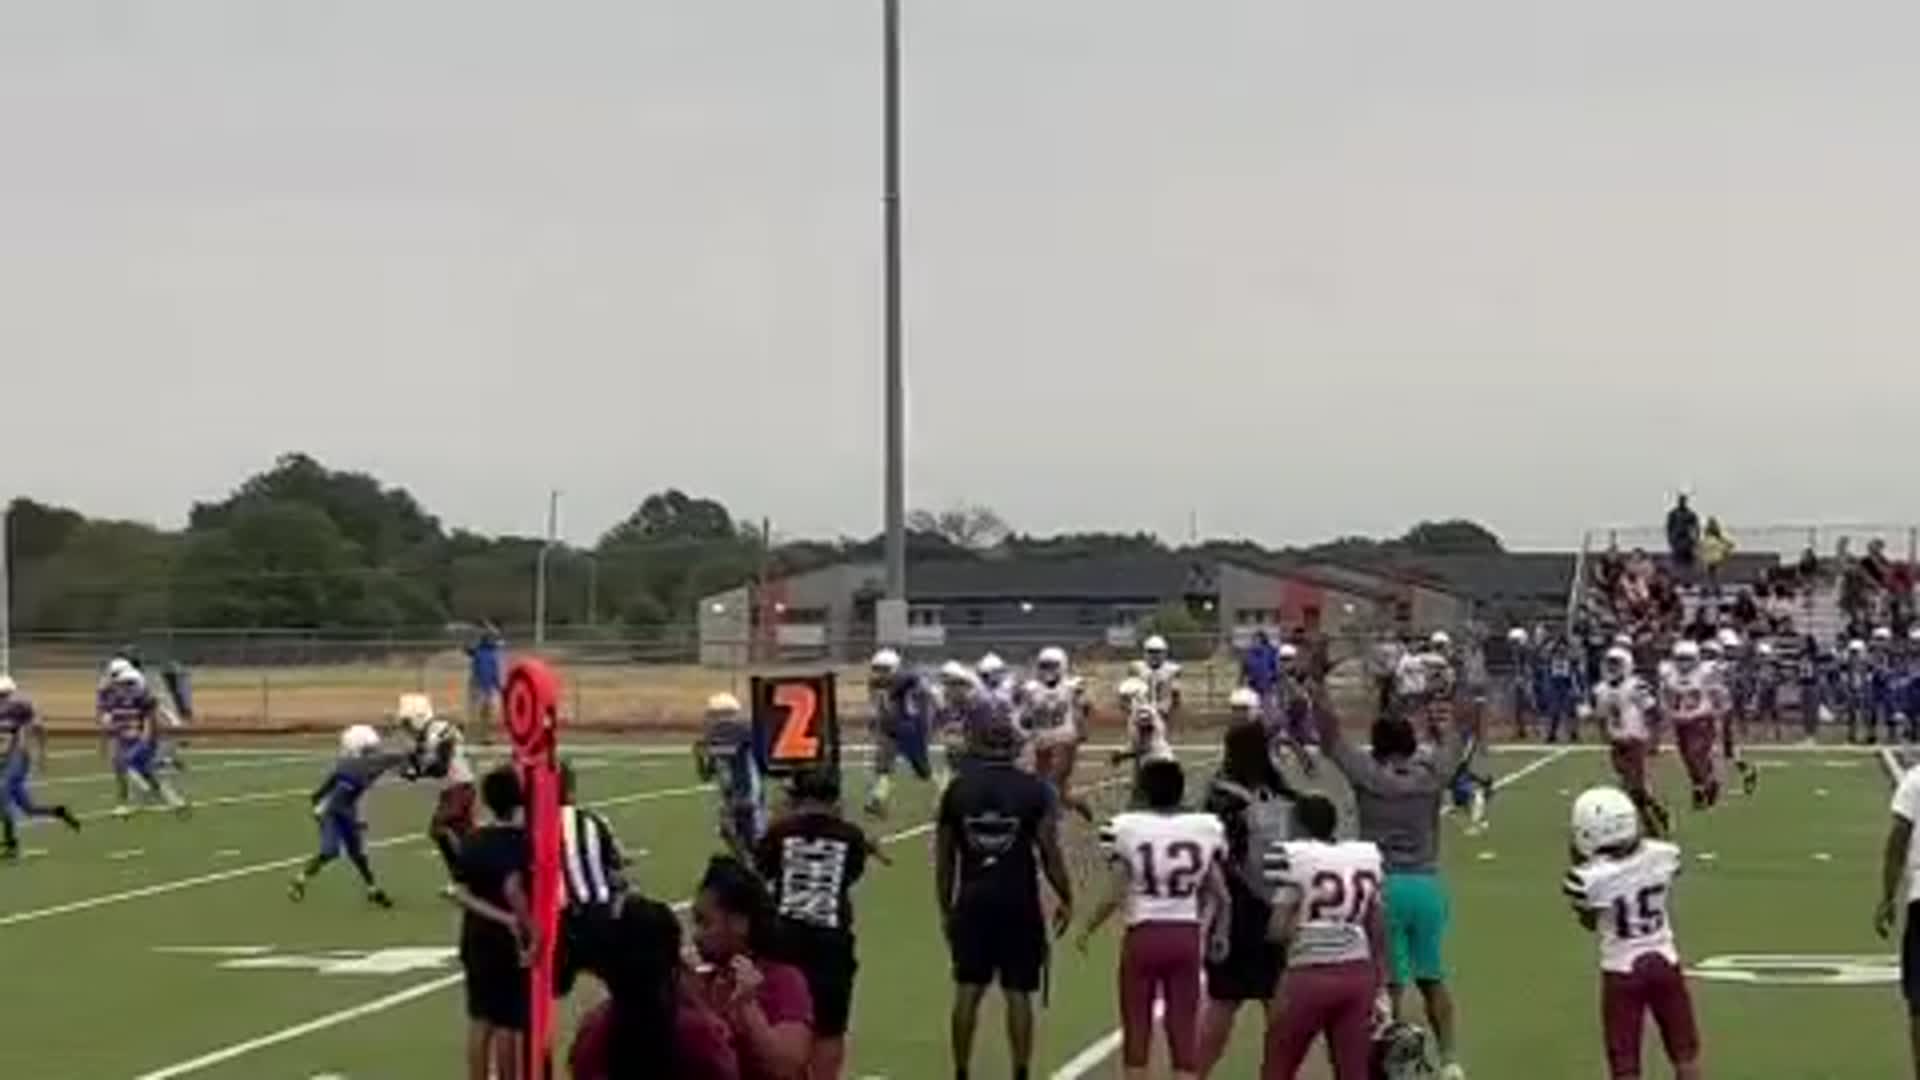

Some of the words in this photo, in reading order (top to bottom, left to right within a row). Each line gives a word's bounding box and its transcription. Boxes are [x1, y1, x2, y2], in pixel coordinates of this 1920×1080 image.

[773, 683, 818, 759] 2
[1135, 841, 1202, 898] 12
[1612, 884, 1666, 939] 15
